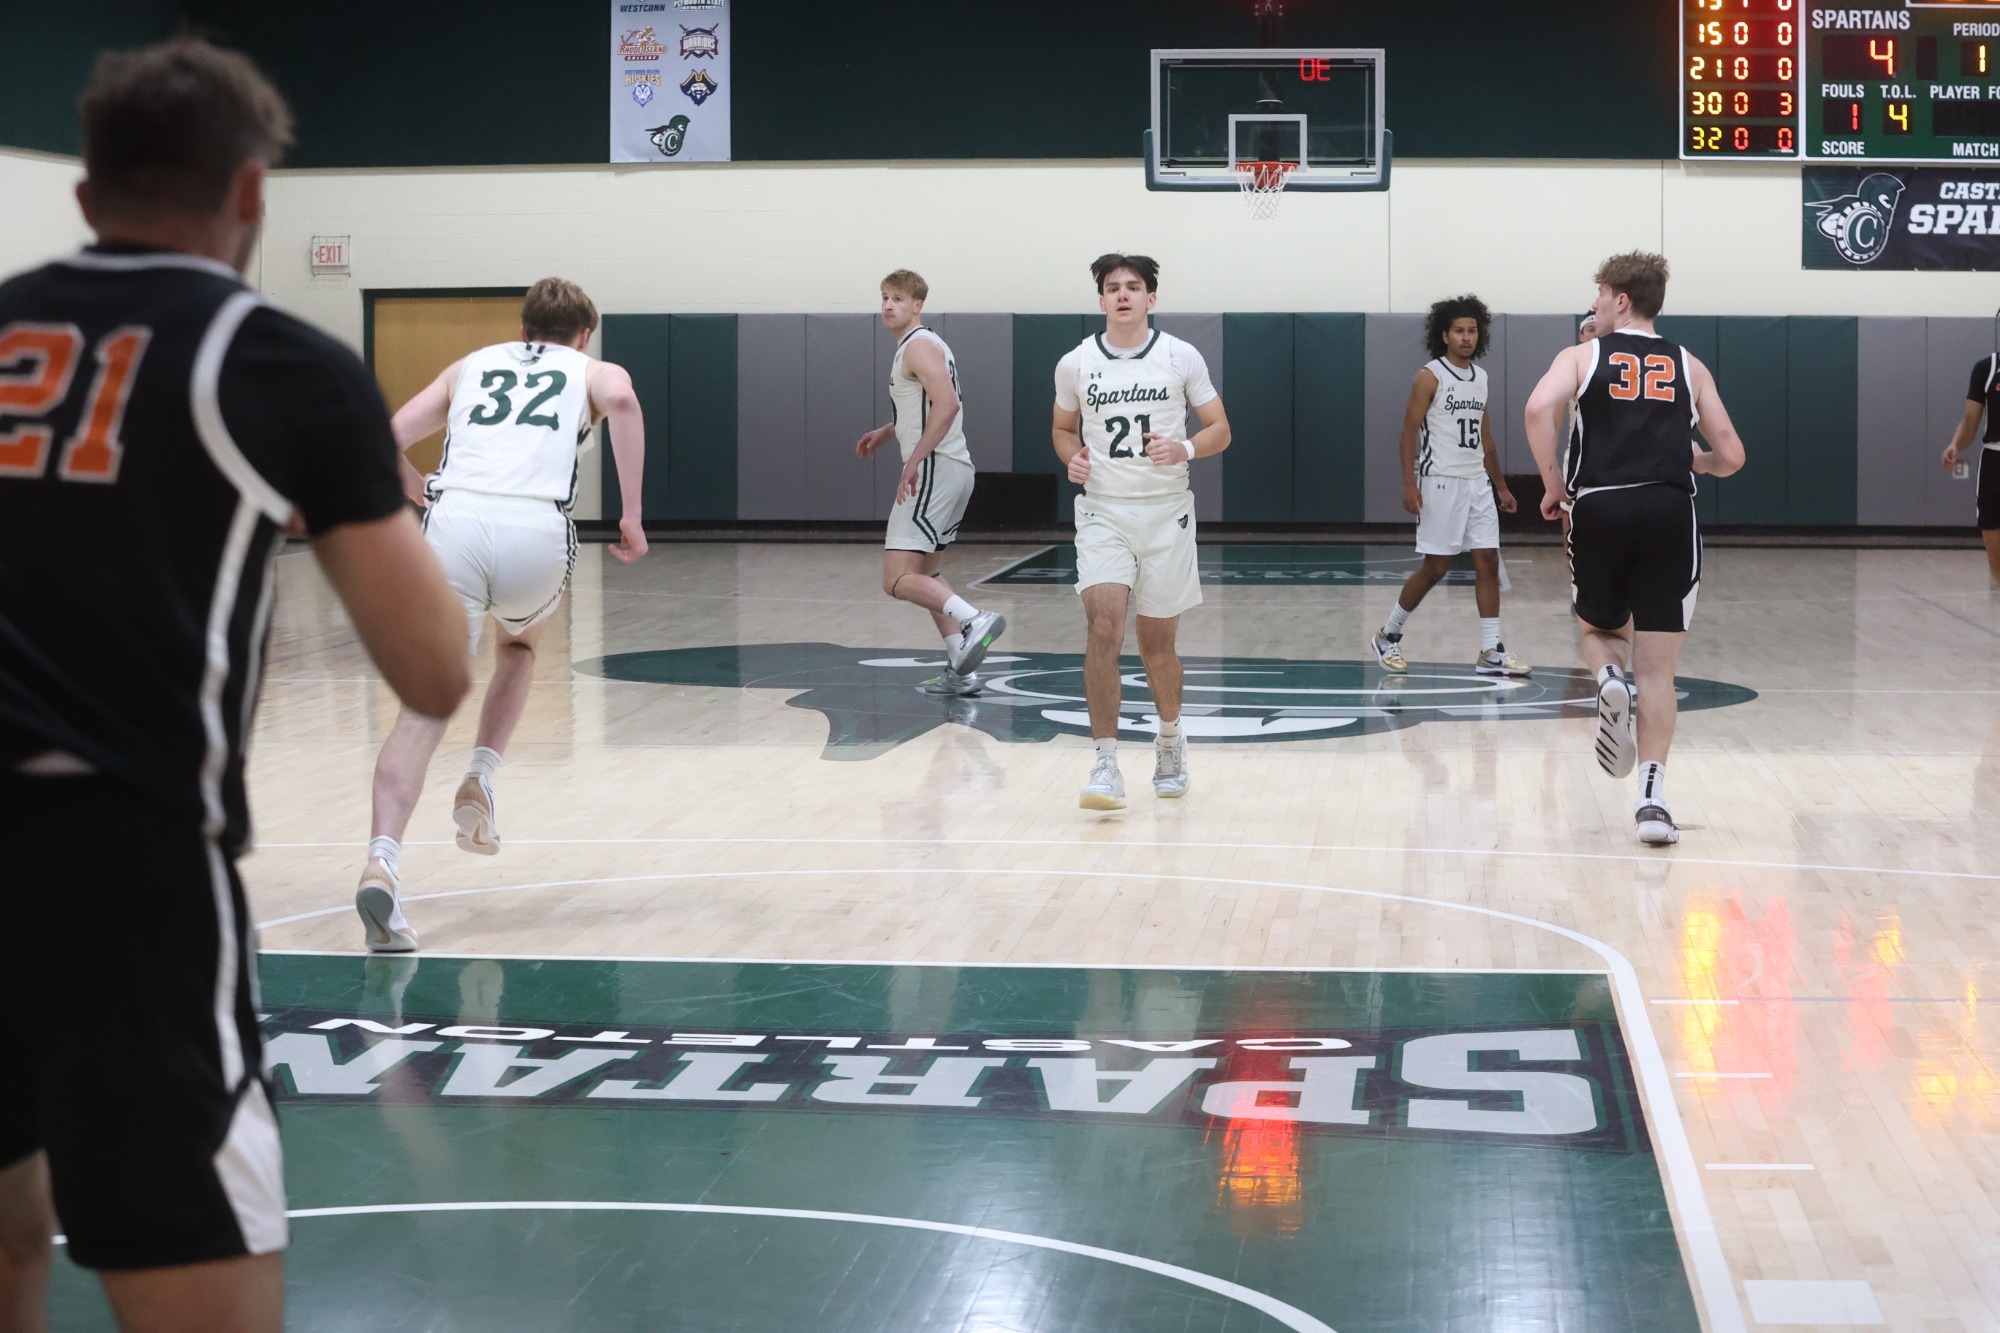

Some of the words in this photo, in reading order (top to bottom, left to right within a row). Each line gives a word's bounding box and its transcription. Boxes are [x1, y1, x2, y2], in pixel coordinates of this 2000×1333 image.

[620, 4, 665, 13] WESTCONN
[1811, 9, 1911, 30] SPARTANS
[1698, 21, 1722, 45] 15
[1734, 21, 1748, 45] 0
[1778, 22, 1792, 45] 0
[1953, 23, 2000, 36] PERIOD
[619, 44, 642, 54] RHODE
[643, 45, 667, 54] ISLAND
[1870, 39, 1893, 75] 4
[1979, 45, 1986, 72] 1
[1690, 56, 1722, 79] 21
[1734, 57, 1748, 80] 0
[1778, 57, 1792, 80] 0
[625, 74, 662, 87] HUSKIES
[1822, 83, 1865, 98] FOULS
[1880, 84, 1917, 99] T.O.L.
[1930, 85, 1980, 99] PLAYER
[1692, 92, 1722, 115] 30
[1734, 92, 1748, 115] 0
[1780, 92, 1792, 116] 3
[1851, 103, 1858, 130] 1
[1888, 104, 1908, 131] 4
[1692, 127, 1722, 150] 32
[1734, 127, 1748, 150] 0
[1778, 127, 1792, 151] 0
[1822, 141, 1865, 155] SCORE
[1952, 142, 1999, 157] MATCH
[1939, 181, 2000, 200] CAST
[319, 245, 343, 263] EXIT
[1608, 351, 1675, 403] 32
[0, 320, 153, 484] 21
[468, 369, 567, 431] 32
[1086, 382, 1169, 413] Spartans
[1444, 394, 1485, 416] Spartan
[1104, 413, 1151, 459] 21
[1456, 418, 1480, 449] 15
[307, 1018, 1353, 1060] CASTLETON
[255, 1014, 1598, 1135] SPARTAN
